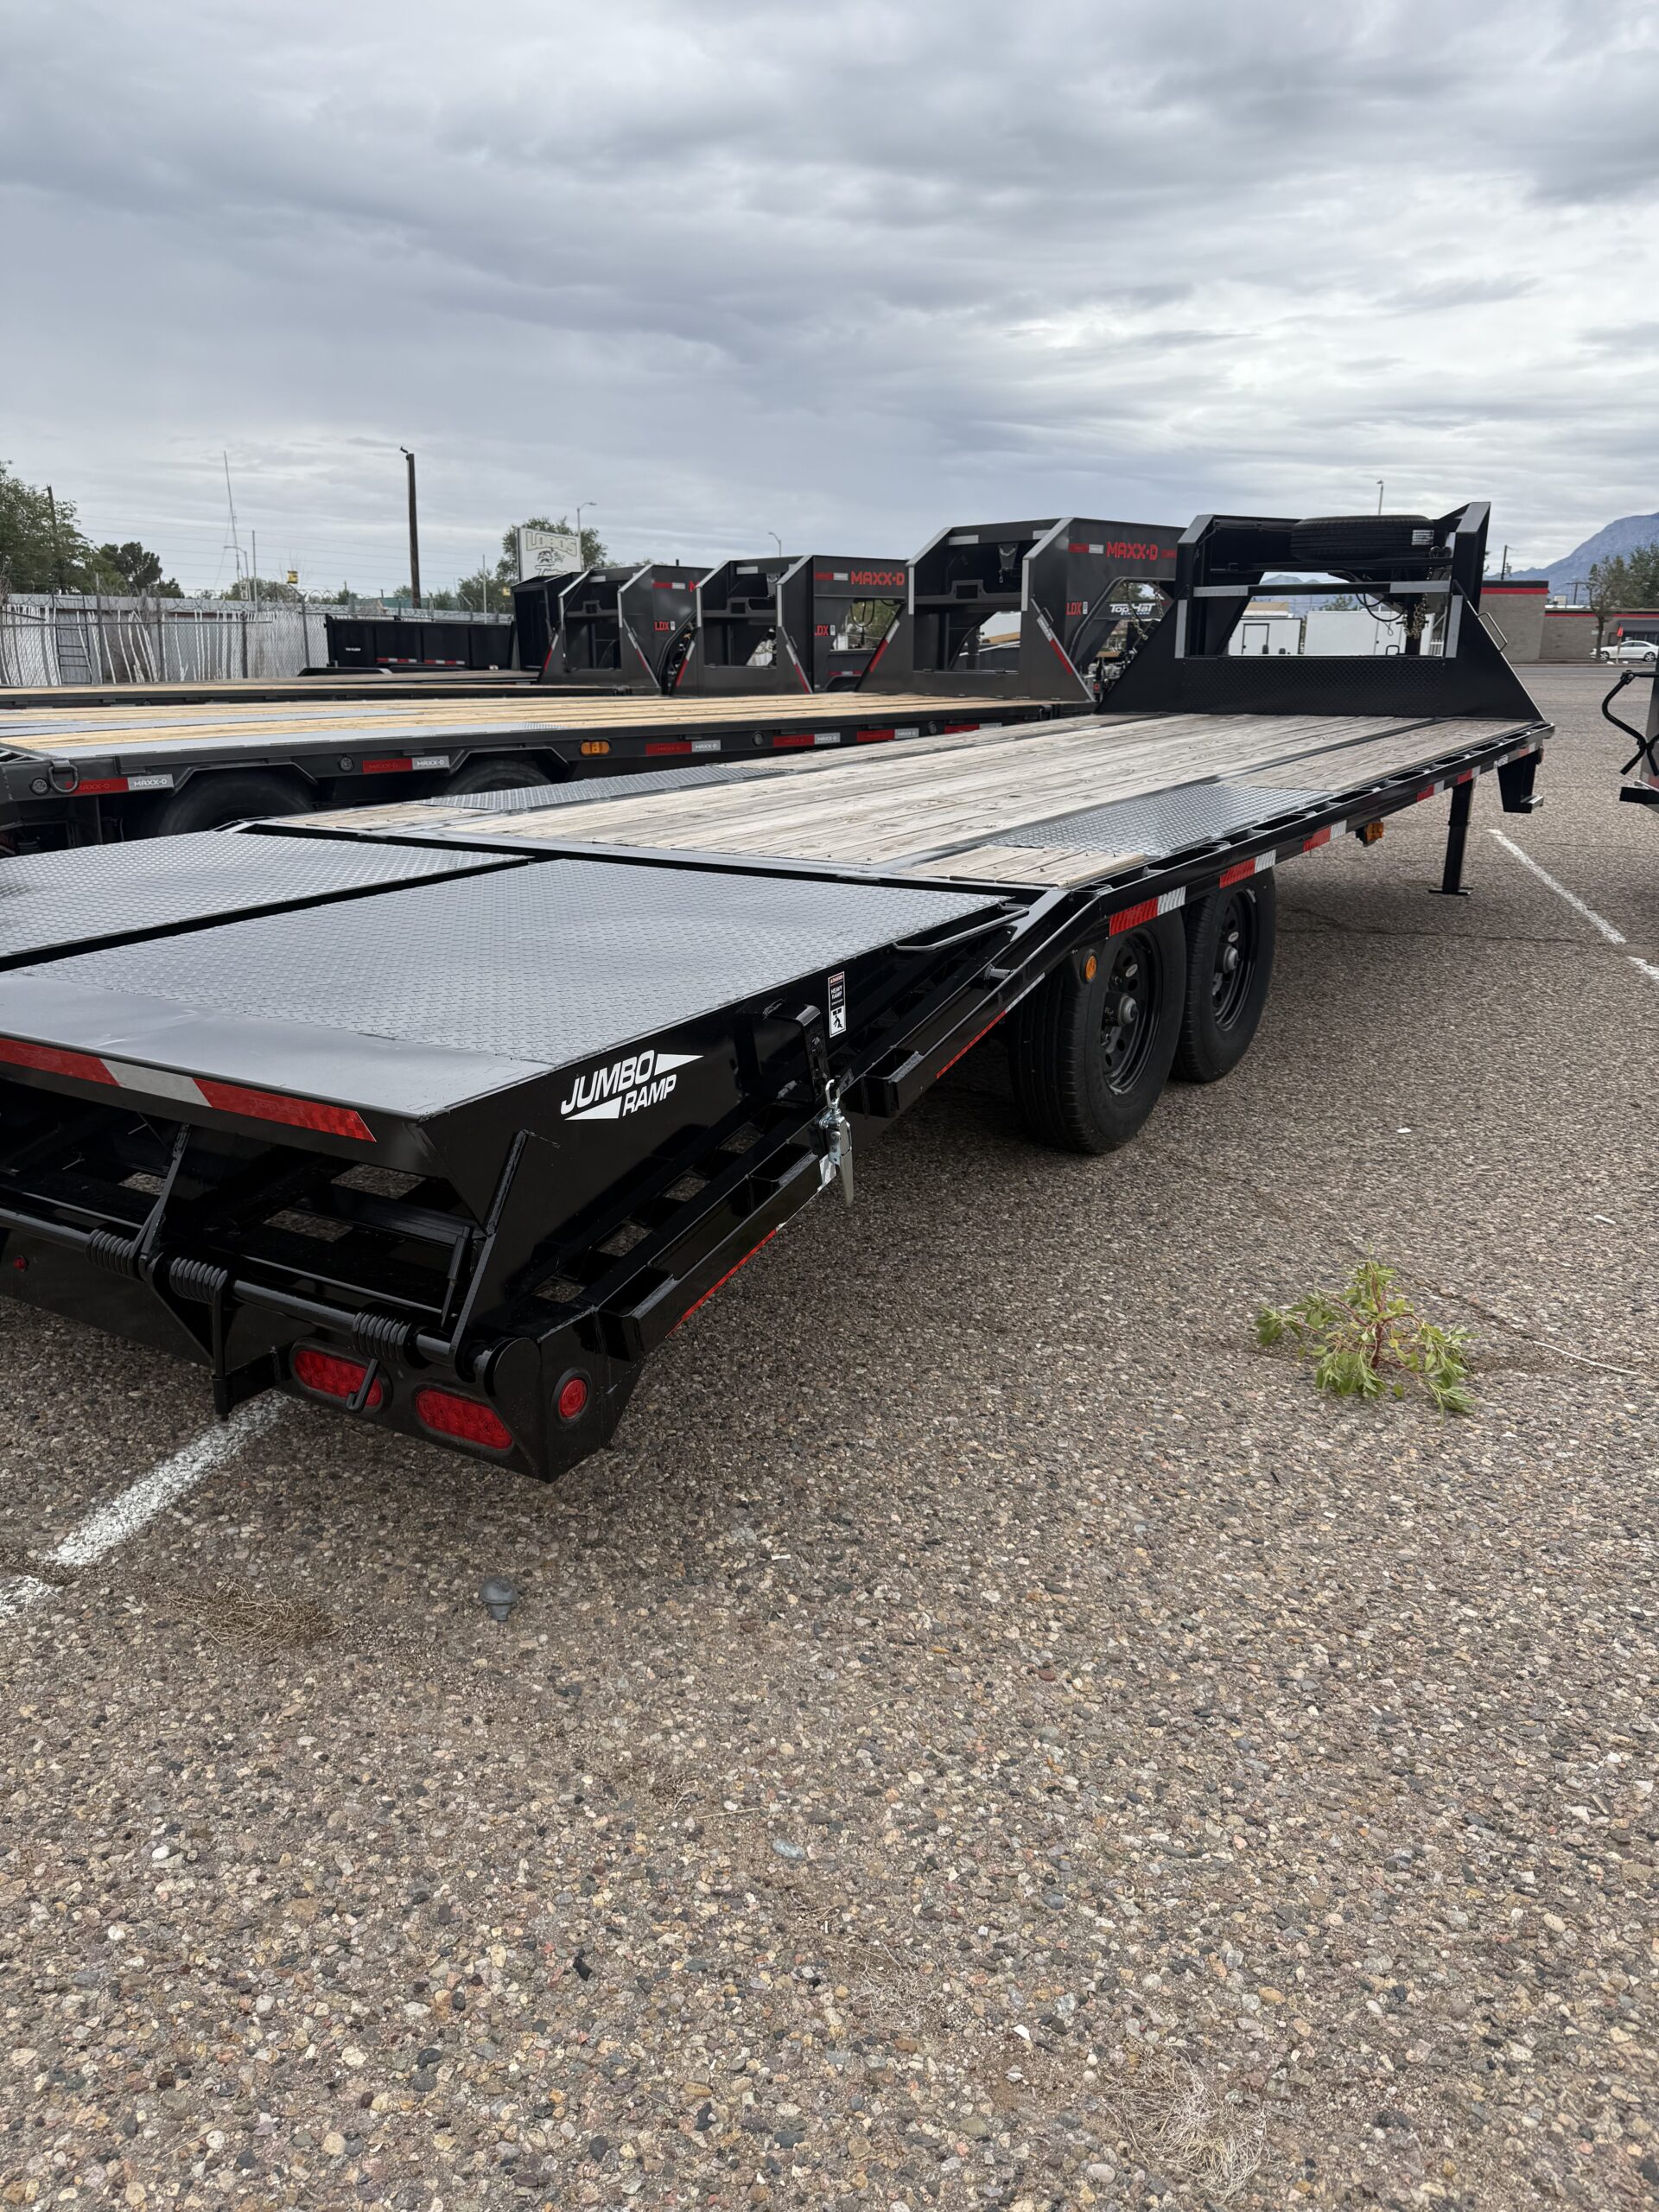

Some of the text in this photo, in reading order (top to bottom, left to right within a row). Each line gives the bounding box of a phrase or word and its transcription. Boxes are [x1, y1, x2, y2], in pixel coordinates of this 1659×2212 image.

[525, 531, 578, 557] LOBOS
[1065, 601, 1082, 615] LDX
[654, 621, 670, 631] LDX
[560, 1049, 655, 1115] JUMBO
[622, 1073, 677, 1117] RAMP
